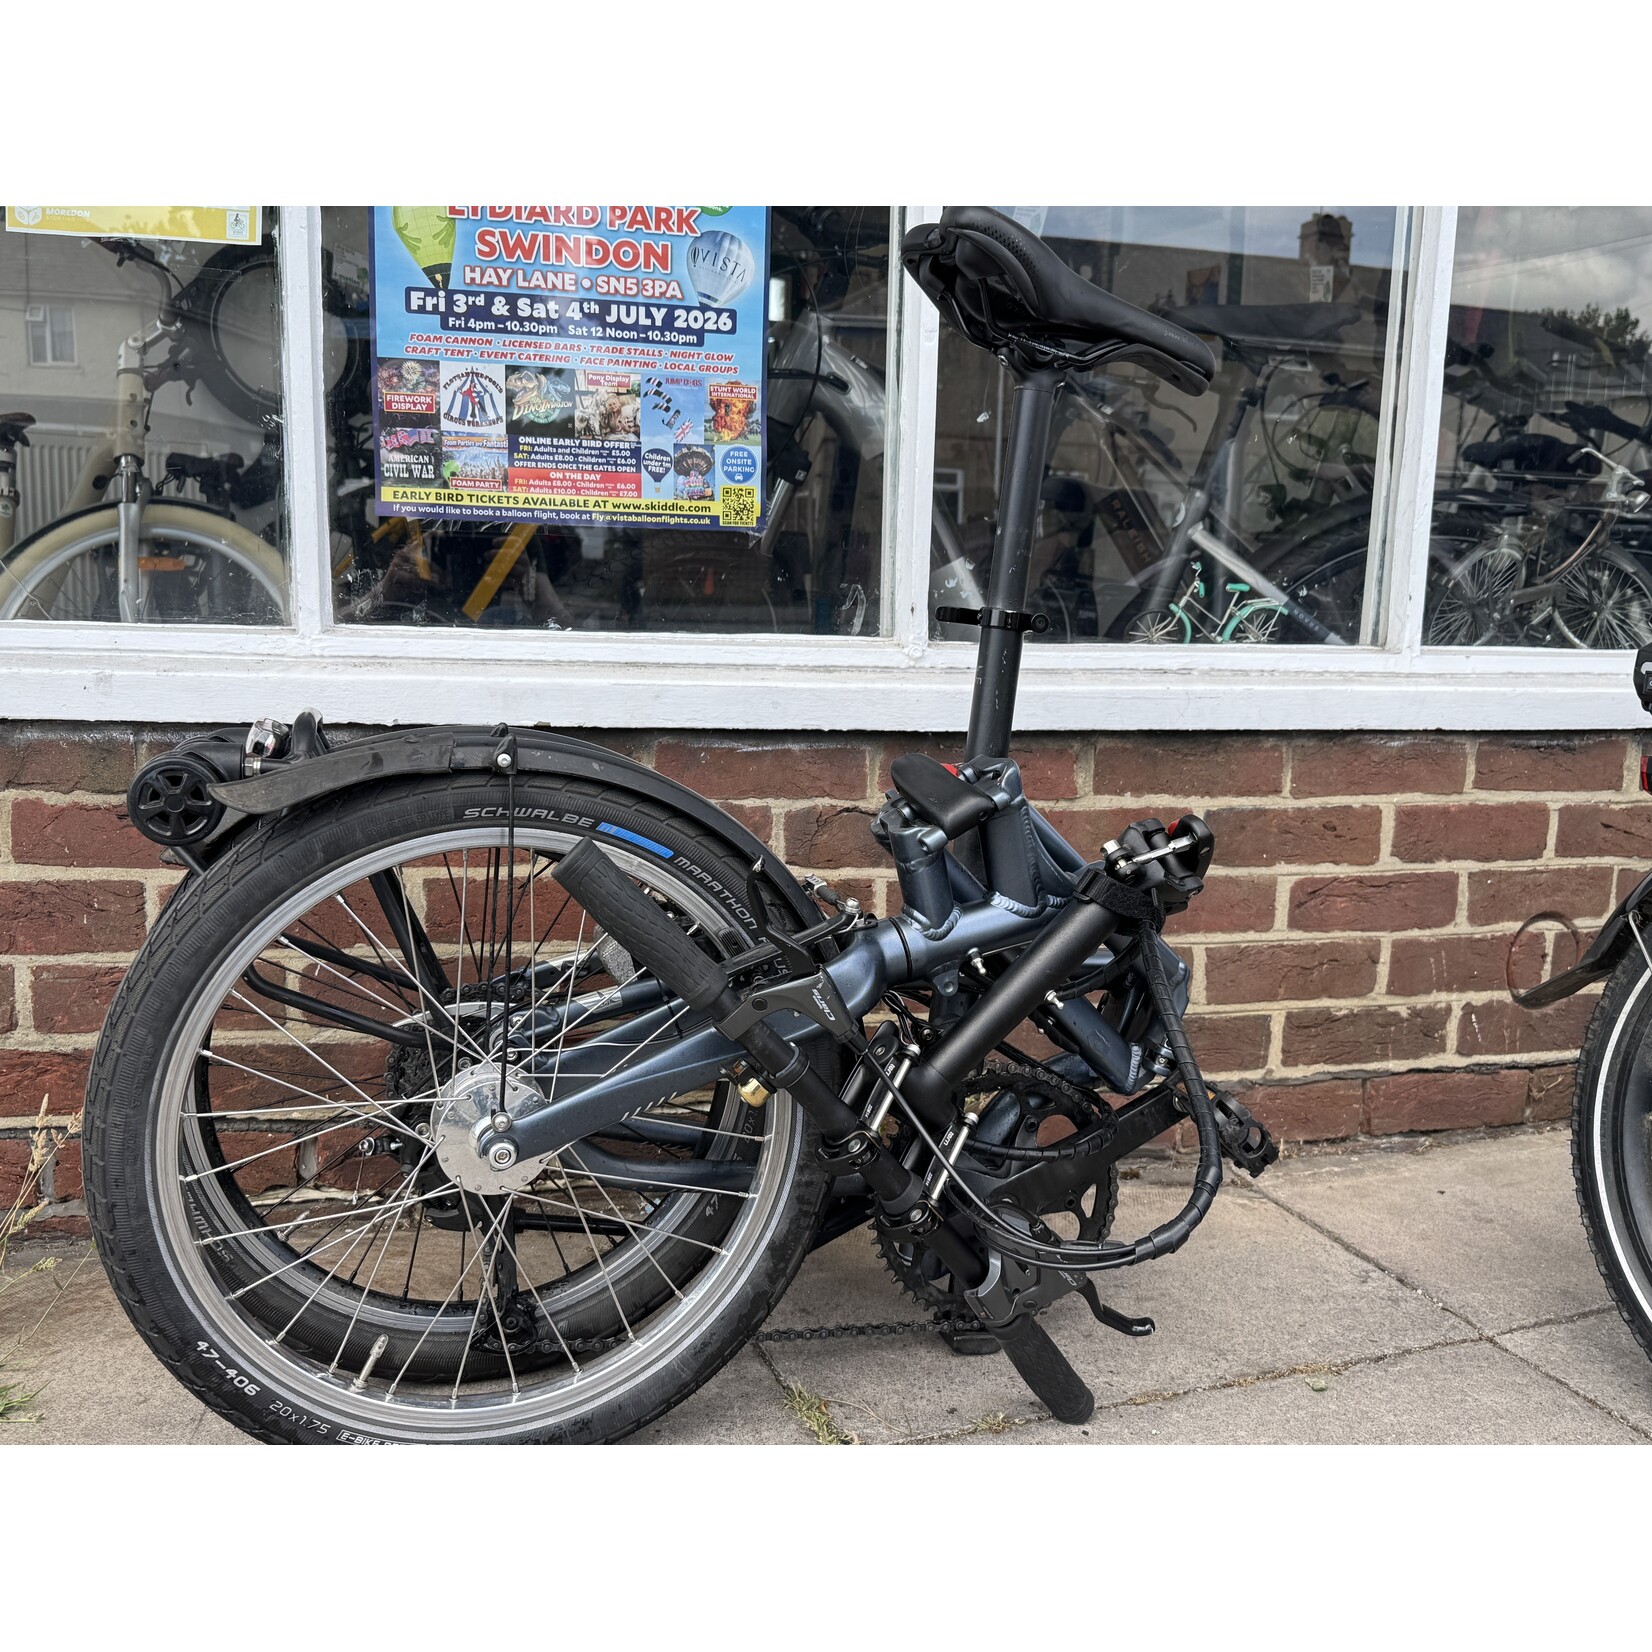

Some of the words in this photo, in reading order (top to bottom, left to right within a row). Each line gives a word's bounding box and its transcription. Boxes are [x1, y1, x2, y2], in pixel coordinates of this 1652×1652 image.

[46, 208, 90, 218] MOREDON
[607, 206, 701, 236] PARK
[476, 228, 671, 273] SWINDON
[701, 248, 746, 282] VISTA
[464, 266, 512, 286] HAY
[517, 270, 576, 291] LANE
[597, 276, 638, 295] SN5
[642, 279, 683, 299] 3PA
[410, 290, 446, 312] Fri
[453, 293, 485, 313] 3rd
[491, 296, 510, 316] &
[517, 298, 559, 319] Sat
[566, 301, 599, 321] 4th
[606, 304, 668, 327] JULY
[674, 309, 733, 331] 2026
[448, 317, 465, 328] Fri
[468, 318, 495, 331] 4pm
[568, 325, 588, 336] Sat
[590, 326, 603, 337] 12
[606, 328, 638, 339] Noon
[410, 334, 443, 343] FOAM
[445, 336, 493, 346] CANNON
[502, 339, 553, 349] LICENSED
[554, 342, 582, 351] BARS
[590, 345, 624, 355] TRADE
[625, 348, 663, 358] STALLS
[669, 350, 703, 360] NIGHT
[704, 353, 734, 362] GLOW
[405, 346, 441, 356] CRAFT
[443, 348, 472, 357] TENT
[480, 350, 514, 360] EVENT
[518, 352, 570, 363] CATERING
[580, 356, 606, 366] FACE
[607, 358, 657, 369] PAINTING
[664, 362, 696, 371] LOCAL
[698, 364, 738, 374] GROUPS
[588, 374, 605, 382] Pony
[605, 375, 630, 383] Display
[386, 394, 432, 404] FIREWORK
[391, 402, 428, 411] DISPLAY
[518, 436, 551, 446] ONLINE
[553, 437, 581, 447] EARLY
[582, 439, 602, 448] BIRD
[603, 439, 630, 449] OFFER
[388, 454, 429, 464] AMERICAN
[513, 452, 529, 460] SAT:
[530, 453, 554, 461] Adults
[571, 448, 600, 456] Children
[644, 452, 671, 462] Children
[513, 460, 537, 468] OFFER
[537, 461, 556, 469] ENDS
[556, 462, 577, 470] ONCE
[578, 463, 593, 471] THE
[593, 464, 616, 472] GATES
[616, 465, 636, 473] OPEN
[723, 465, 755, 473] PARKING
[726, 458, 752, 466] ONSITE
[383, 463, 409, 478] CIVIL
[412, 464, 435, 478] WAR
[549, 471, 564, 479] ON
[564, 472, 582, 480] THE
[583, 473, 601, 481] DAY
[648, 466, 666, 474] FREE!
[452, 479, 474, 487] FOAM
[475, 481, 500, 489] PARTY
[528, 478, 552, 486] Adults
[576, 481, 605, 489] Children
[529, 486, 553, 494] Adults
[580, 488, 609, 496] Children
[393, 491, 432, 501] EARLY
[435, 492, 464, 502] BIRD
[467, 494, 519, 505] TICKETS
[522, 497, 590, 508] AVAILABLE
[592, 500, 609, 509] AT
[612, 501, 711, 513] www.skiddle.com
[393, 504, 400, 512] If
[418, 506, 445, 514] would
[445, 507, 461, 515] like
[462, 508, 472, 516] to
[473, 508, 494, 516] book
[502, 509, 533, 519] balloon
[533, 510, 559, 520] flight,
[560, 511, 581, 520] book
[1111, 498, 1152, 563] RALEIGH
[462, 807, 596, 828] SCHWALBE
[673, 856, 758, 930] MARATHON
[943, 1131, 955, 1146] tern
[196, 1340, 261, 1397] 47-406
[269, 1400, 332, 1435] 20x1.75
[340, 1431, 380, 1445] E-BIKE
